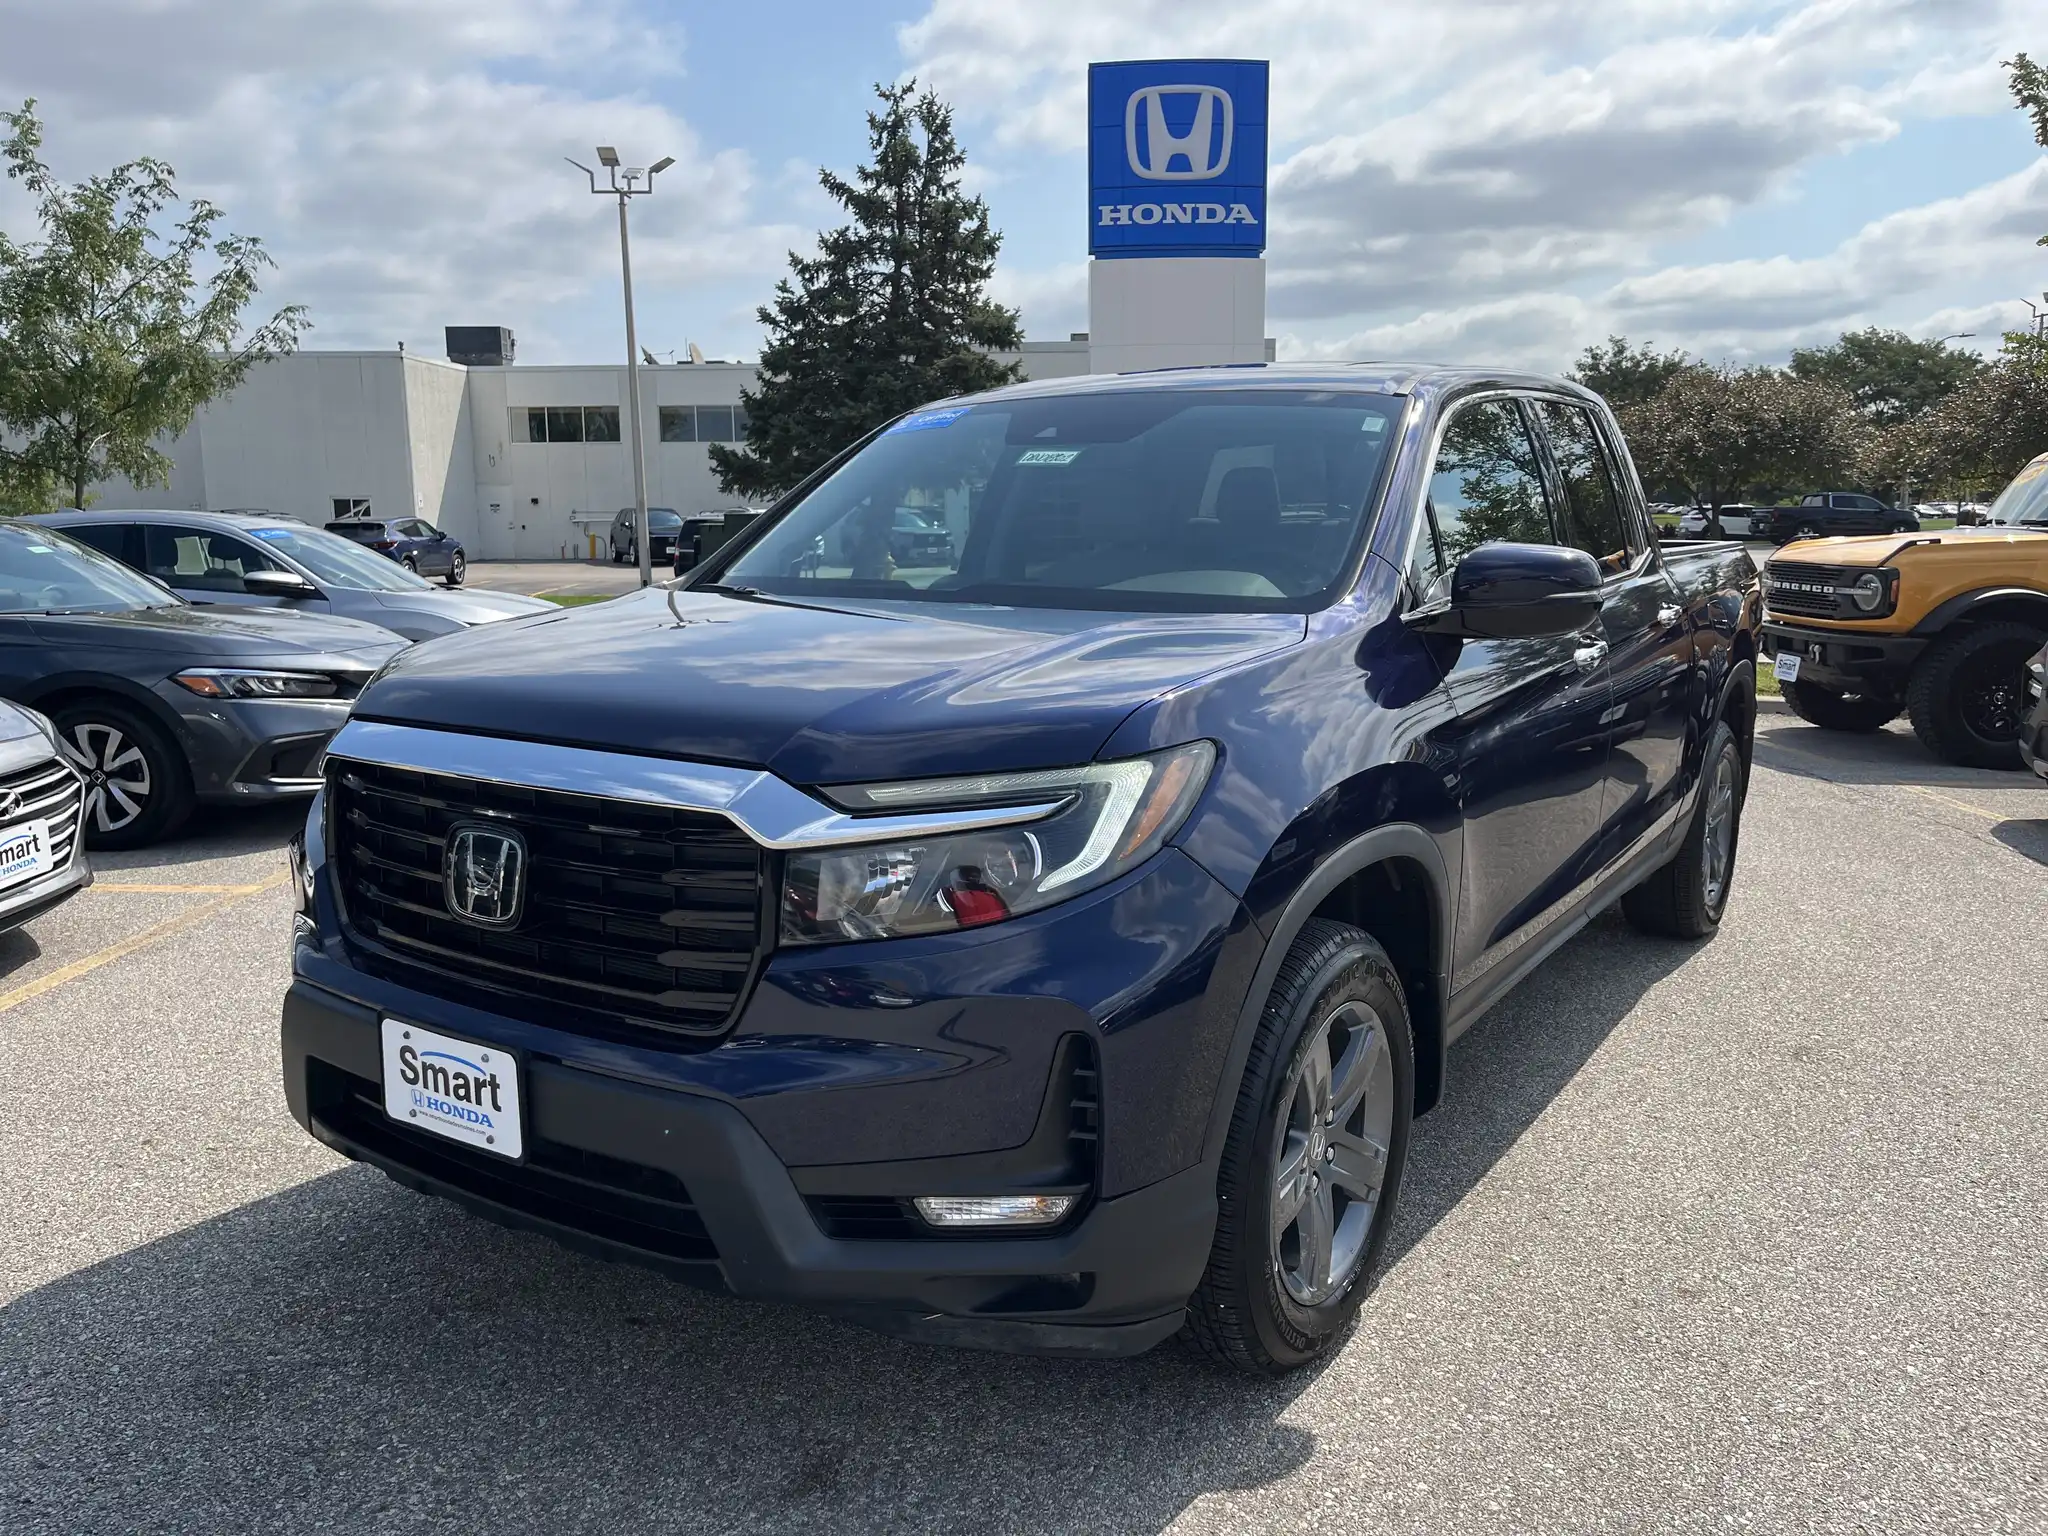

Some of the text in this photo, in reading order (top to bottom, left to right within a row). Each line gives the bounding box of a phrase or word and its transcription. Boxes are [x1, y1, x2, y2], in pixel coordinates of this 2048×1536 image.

[1098, 203, 1259, 226] HONDA
[1773, 581, 1835, 594] BRONCO
[2, 857, 38, 875] HONDA
[399, 1044, 502, 1113] Smart
[426, 1096, 495, 1129] HONDA
